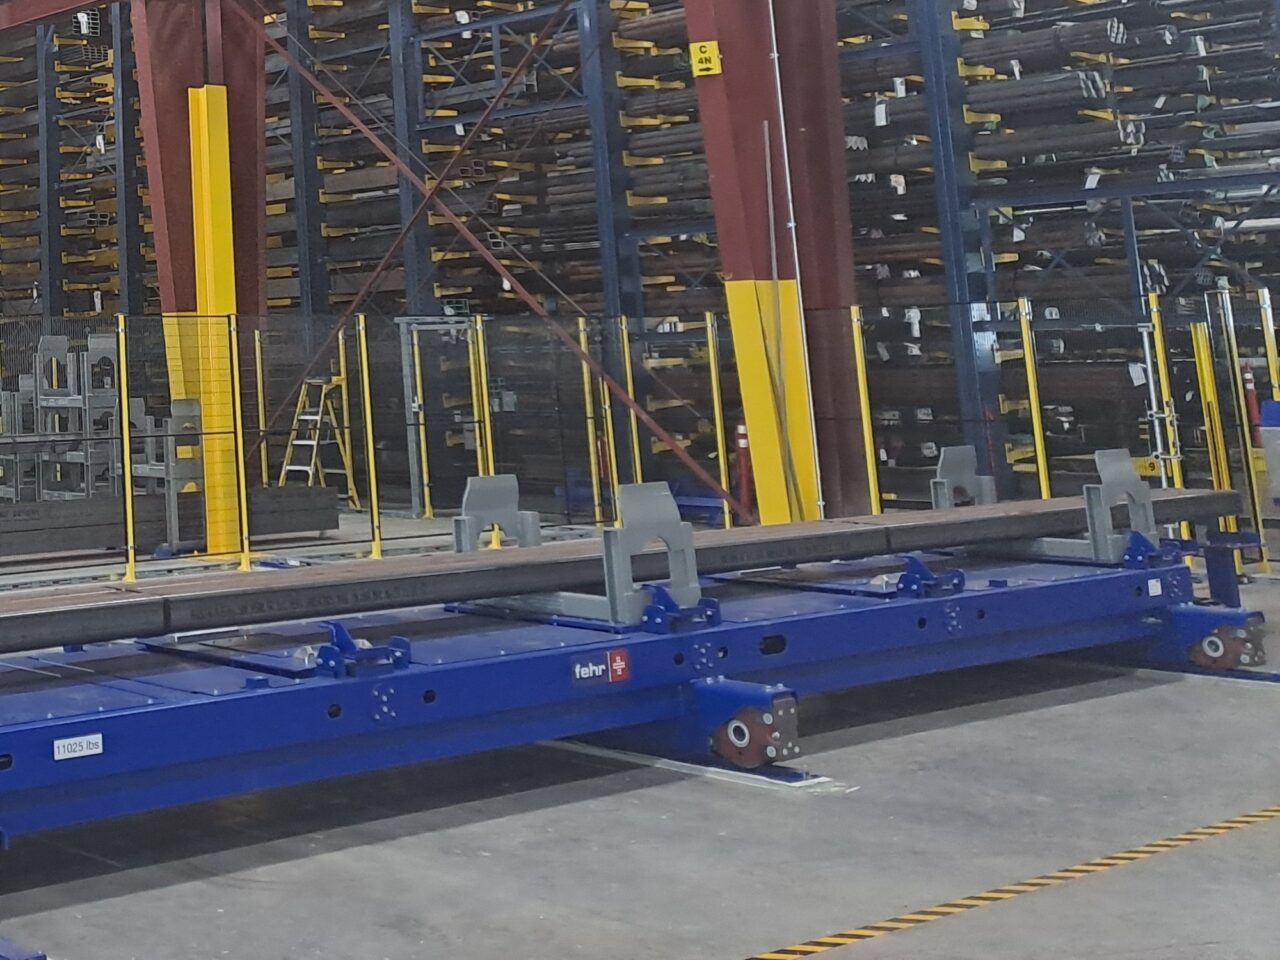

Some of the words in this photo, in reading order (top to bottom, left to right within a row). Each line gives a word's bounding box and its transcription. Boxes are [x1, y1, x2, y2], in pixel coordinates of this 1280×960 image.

[699, 45, 708, 54] C
[698, 56, 712, 65] 4N
[575, 662, 606, 679] fehr
[56, 741, 84, 755] 11025
[86, 740, 100, 751] lbs
